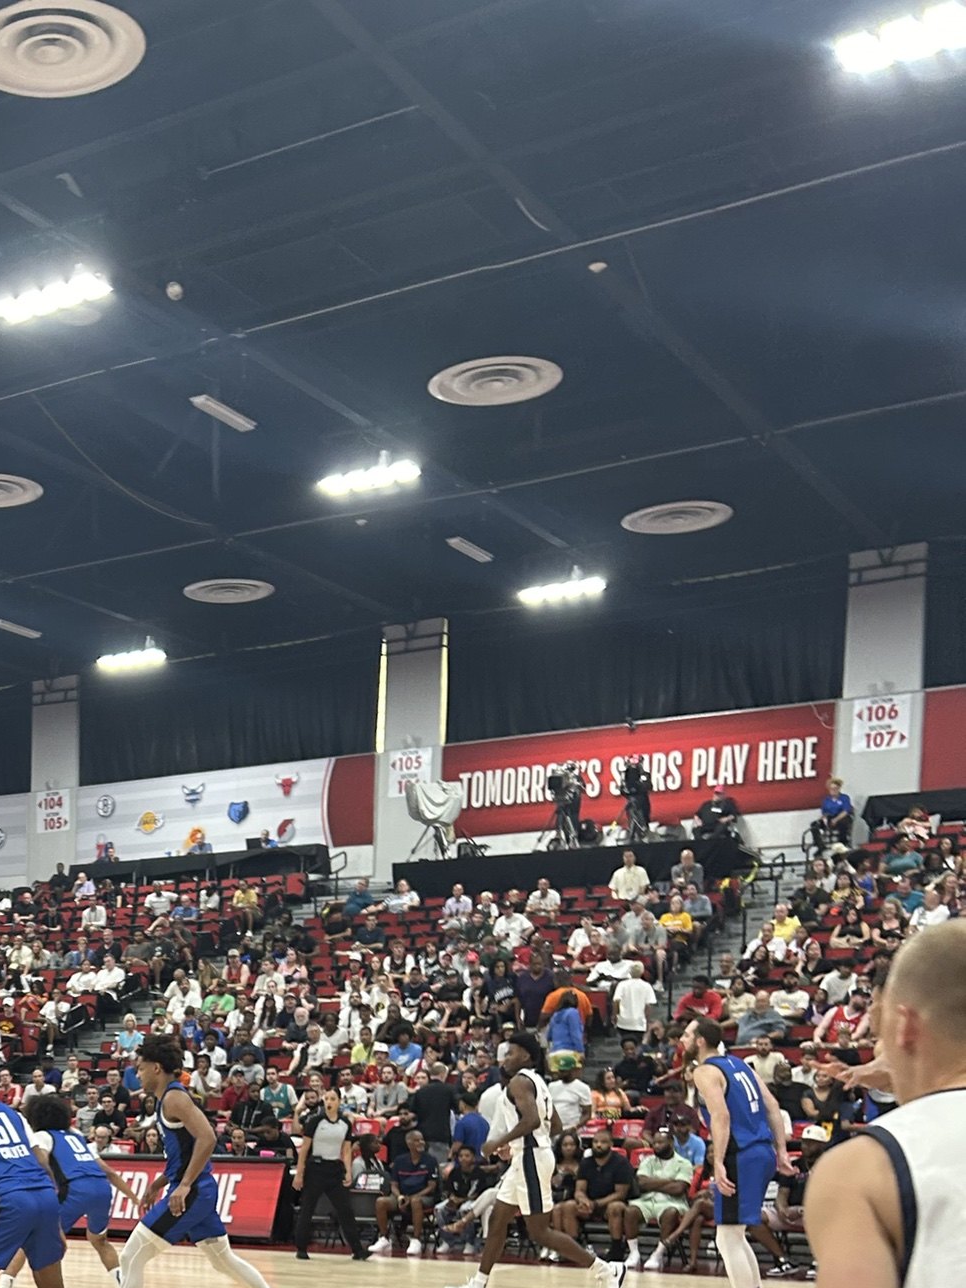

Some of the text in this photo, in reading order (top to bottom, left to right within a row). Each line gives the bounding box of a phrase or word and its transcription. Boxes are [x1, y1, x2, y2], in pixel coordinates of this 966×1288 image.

[867, 703, 899, 721] 106
[865, 730, 897, 749] 107
[398, 755, 422, 771] 105
[459, 736, 818, 809] TOMORRO'S SRS PLAY HERE
[43, 796, 63, 810] 104
[43, 817, 63, 831] 105
[733, 1070, 759, 1102] 71
[64, 1134, 87, 1154] 0
